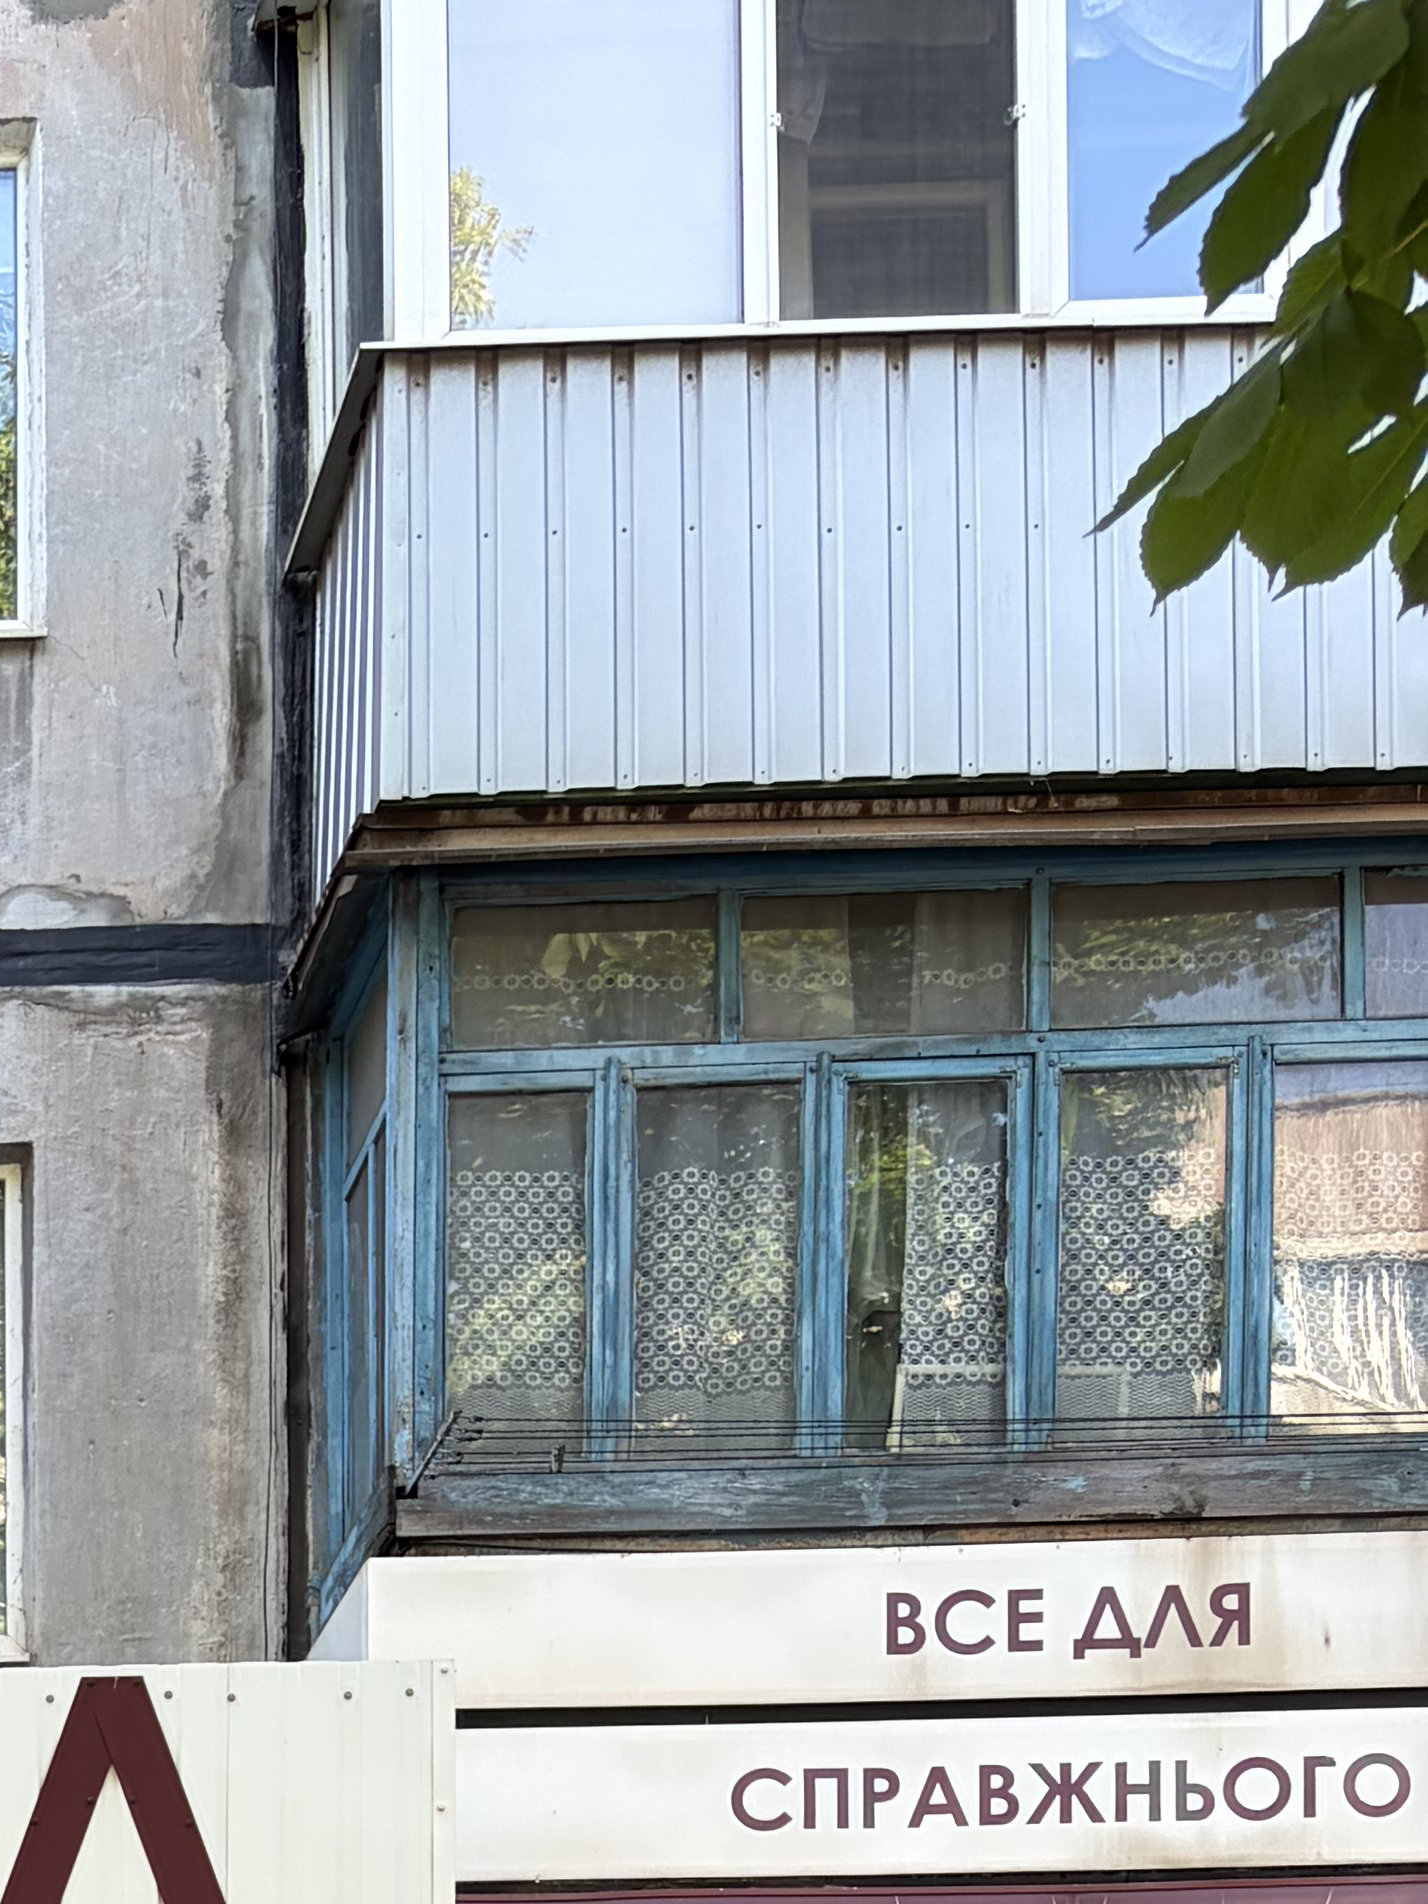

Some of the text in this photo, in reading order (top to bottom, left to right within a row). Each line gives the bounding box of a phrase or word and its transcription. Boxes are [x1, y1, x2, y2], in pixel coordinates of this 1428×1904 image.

[886, 1582, 1253, 1663] ВСЕ ДЛЯ
[730, 1752, 1413, 1832] СПРАВЖНЬОГО
